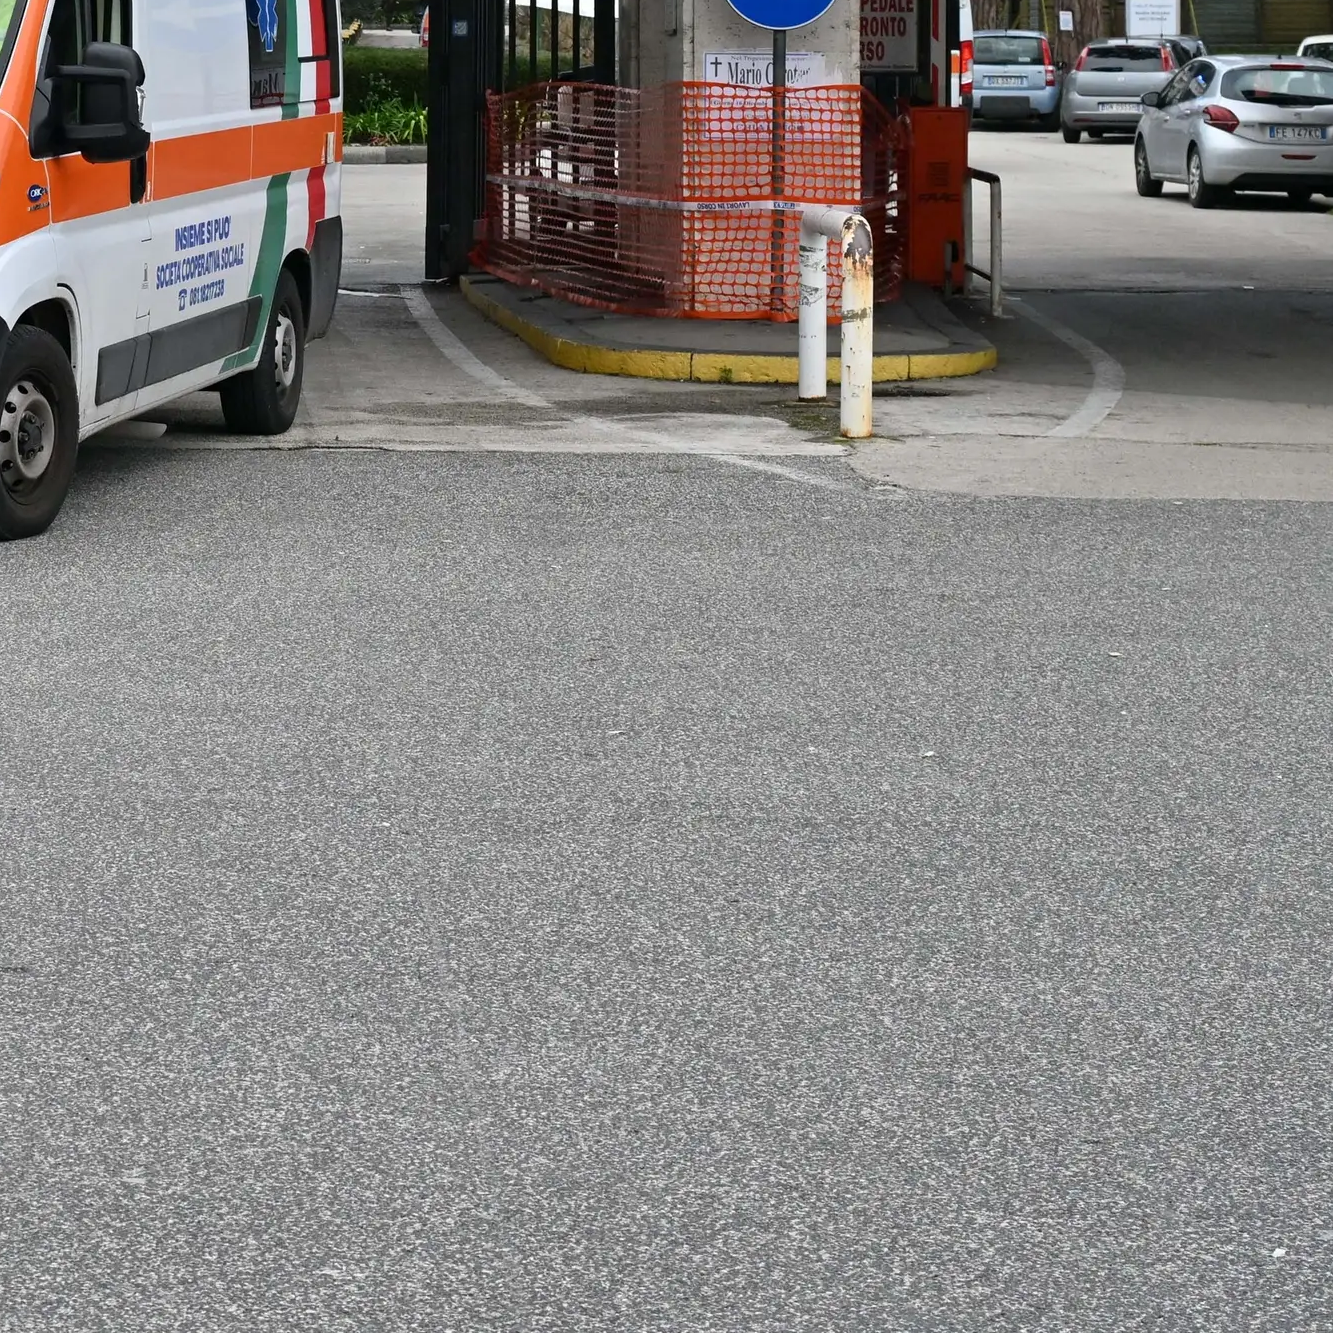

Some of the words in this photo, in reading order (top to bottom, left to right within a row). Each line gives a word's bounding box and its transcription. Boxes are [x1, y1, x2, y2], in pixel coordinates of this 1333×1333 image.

[860, 16, 907, 37] RONTO
[727, 61, 762, 85] Mario
[697, 202, 717, 210] CORSO
[717, 202, 726, 210] IN
[725, 201, 750, 210] LAVORI
[175, 222, 206, 252] INSIEME
[206, 220, 213, 244] SI
[182, 249, 220, 282] COOPERATIVA
[221, 243, 244, 271] SOCIALE
